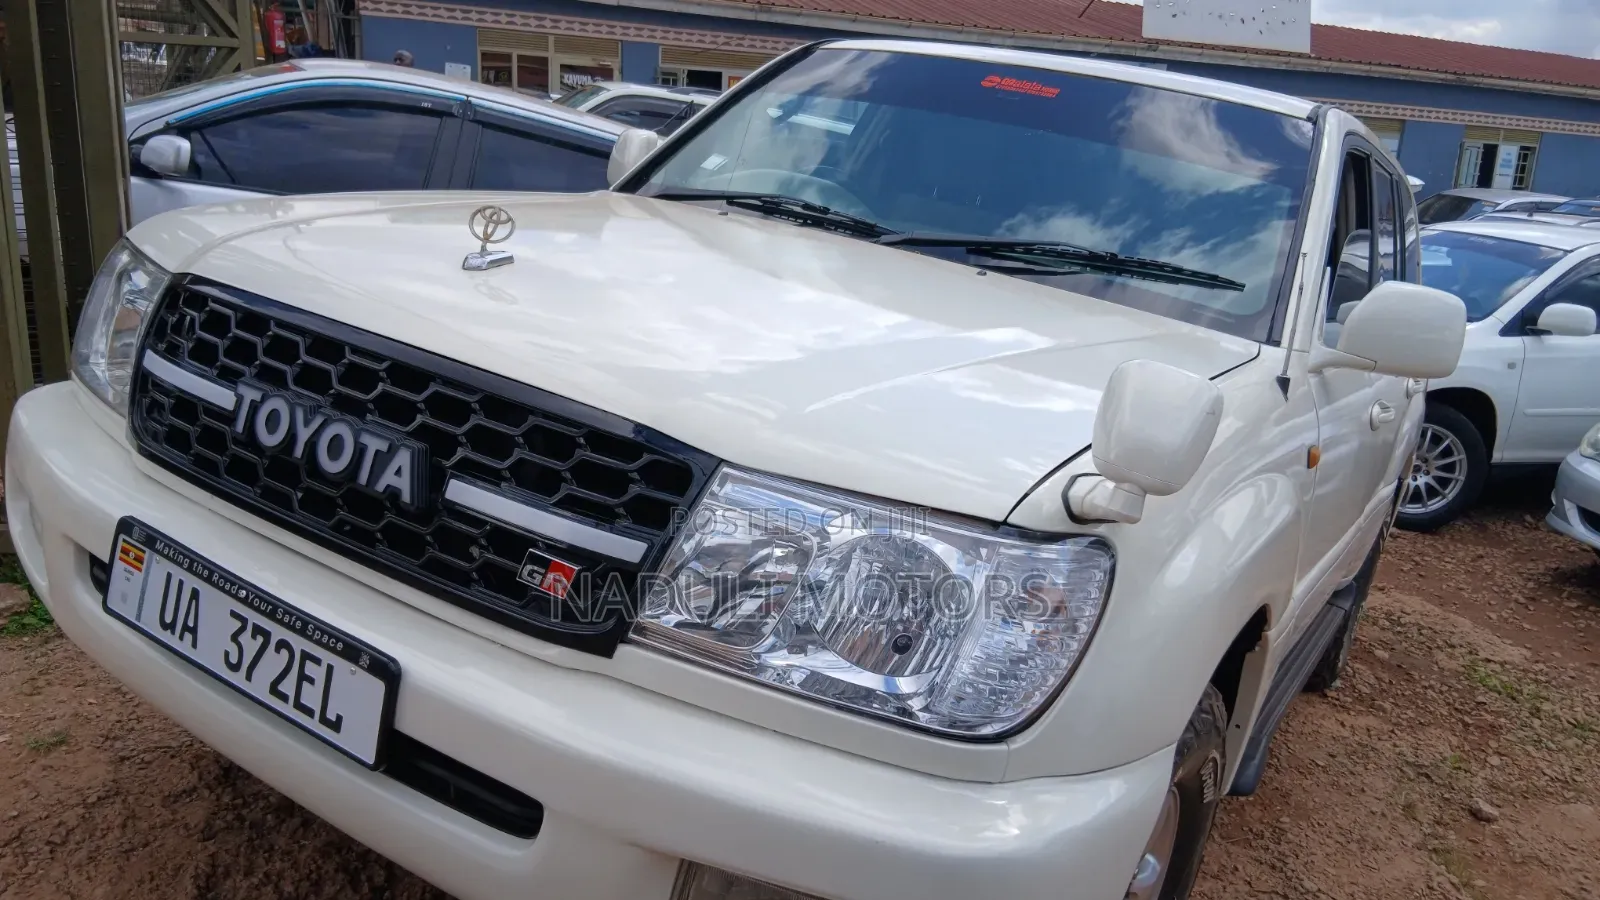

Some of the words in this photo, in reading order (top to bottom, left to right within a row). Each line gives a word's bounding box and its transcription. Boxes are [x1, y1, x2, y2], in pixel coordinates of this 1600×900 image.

[235, 383, 414, 504] TOYOTA
[155, 539, 191, 568] Making
[193, 559, 209, 578] the
[247, 591, 273, 613] Your
[276, 608, 302, 630] Safe
[306, 624, 344, 651] Space
[521, 564, 569, 598] GR
[159, 571, 200, 650] UA
[224, 608, 343, 734] 372EL
